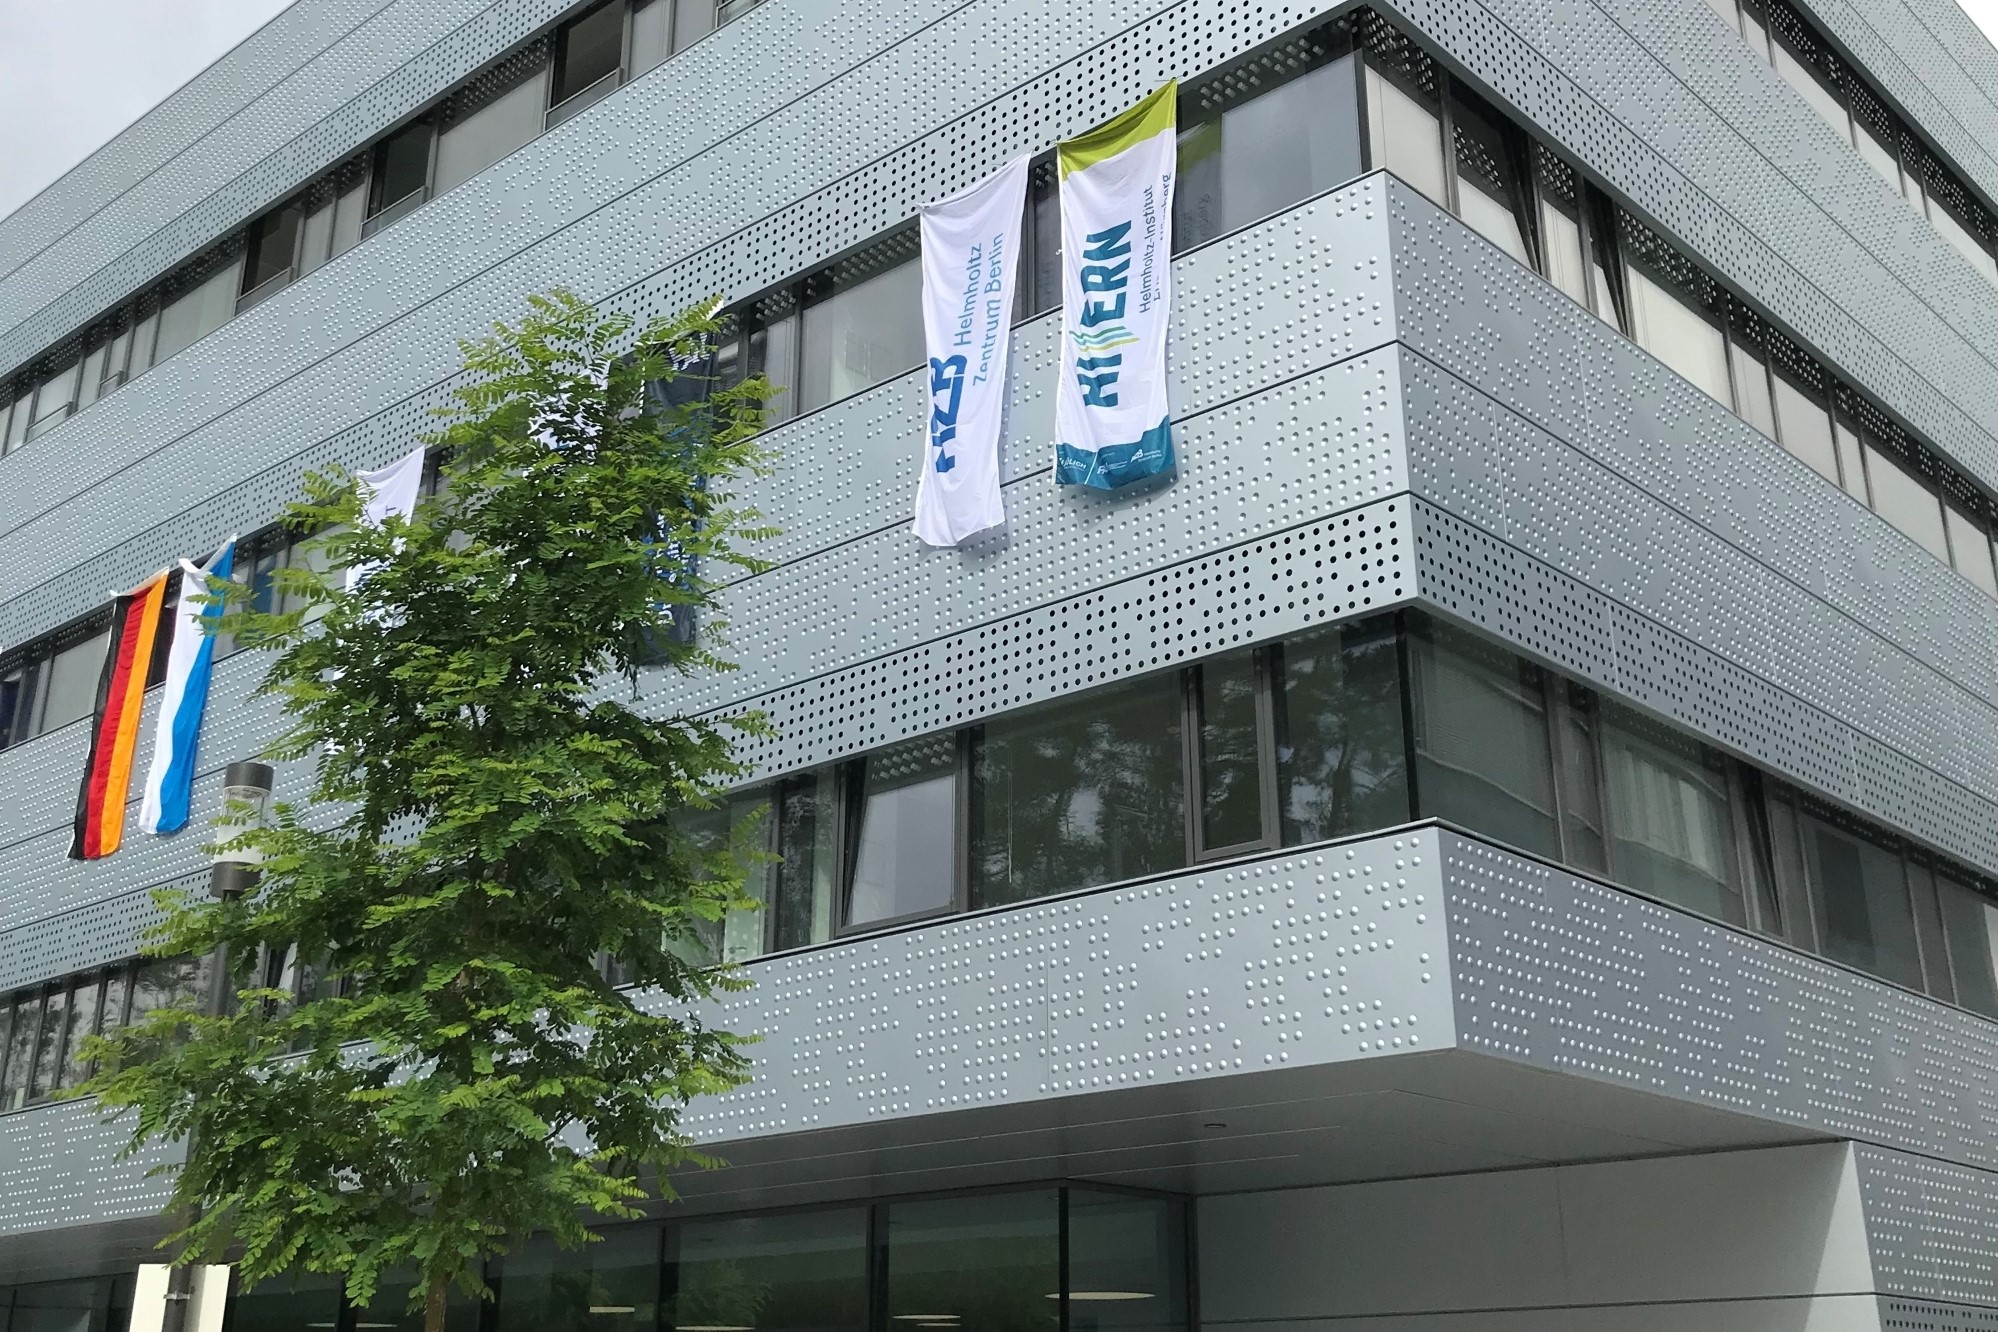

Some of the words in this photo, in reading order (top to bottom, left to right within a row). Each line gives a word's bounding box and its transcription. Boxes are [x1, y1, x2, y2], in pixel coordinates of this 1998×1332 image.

[953, 242, 982, 346] Helmholtz
[984, 232, 1003, 295] Berlin
[1139, 185, 1156, 313] Helmholtz-Institut
[973, 299, 1001, 387] Zentrum
